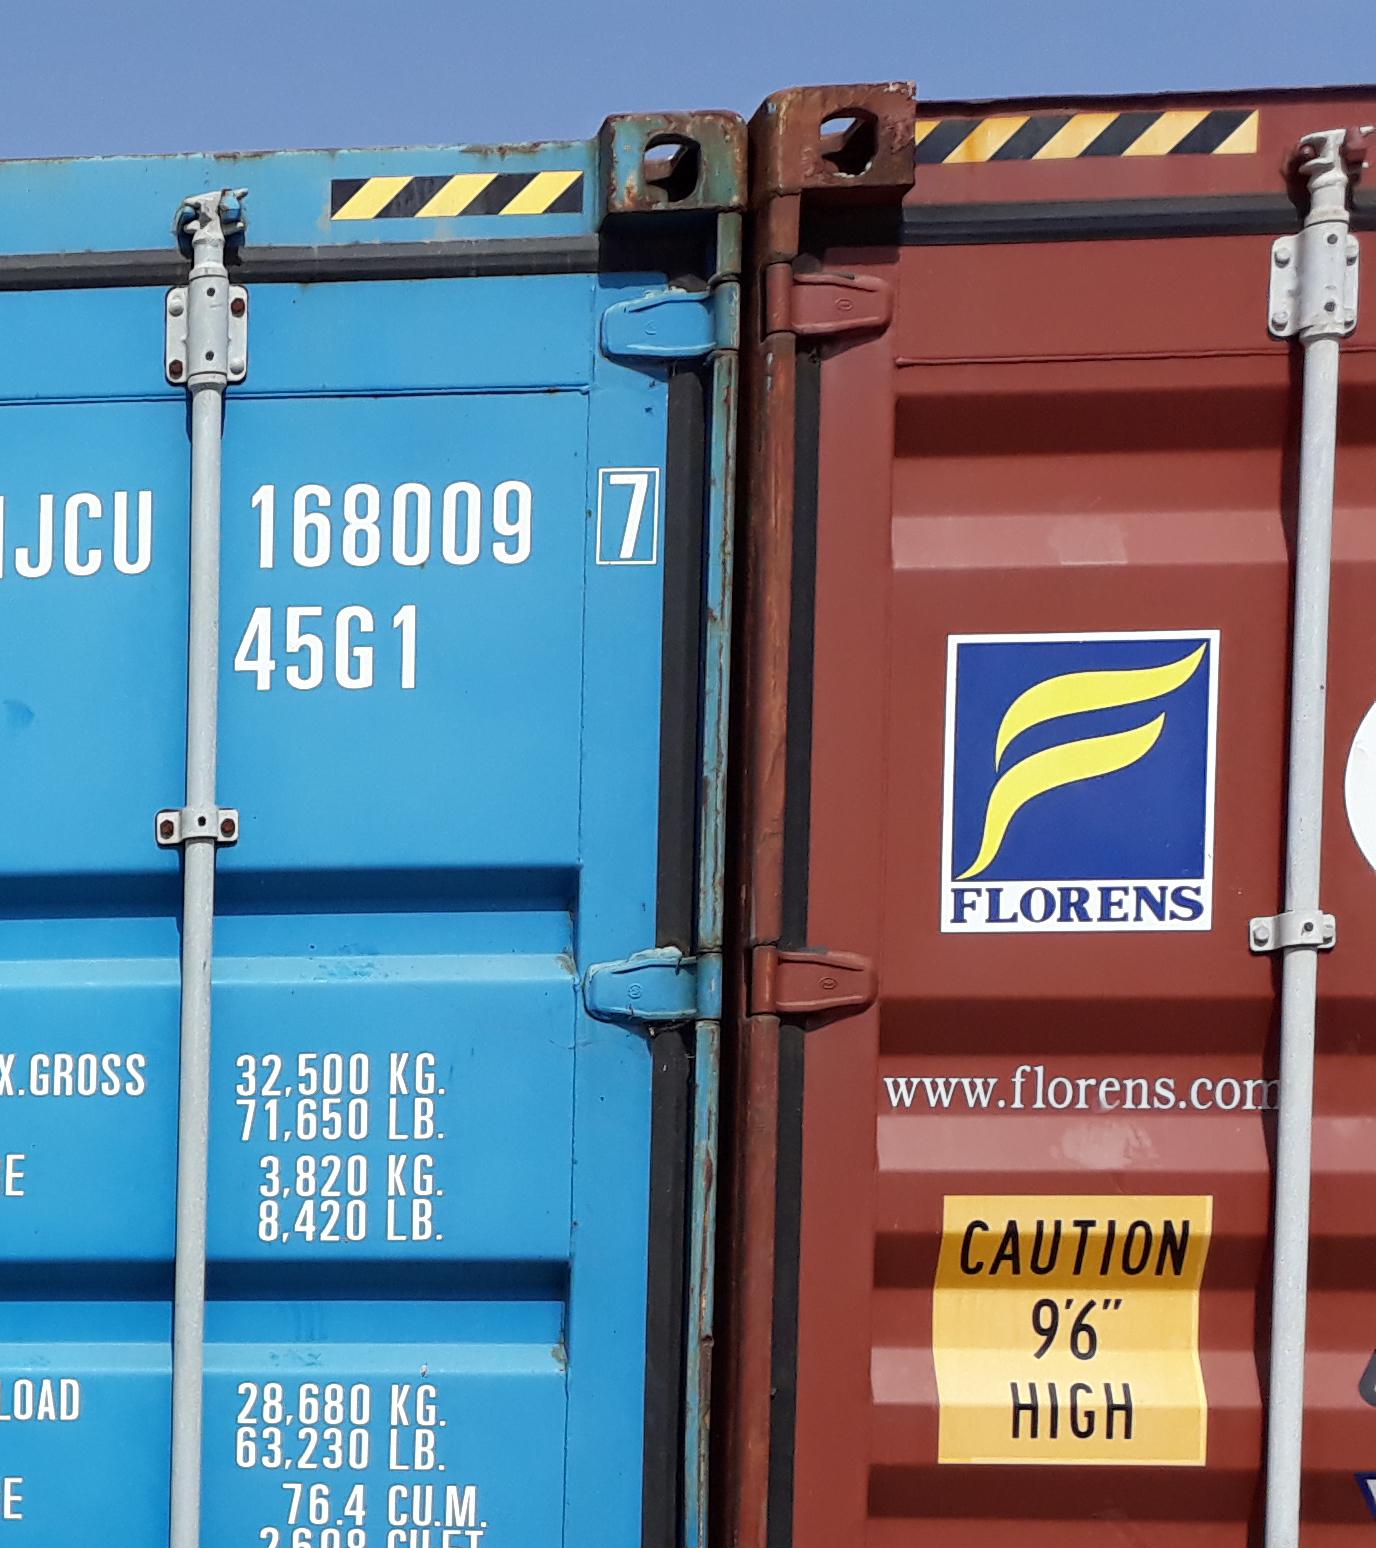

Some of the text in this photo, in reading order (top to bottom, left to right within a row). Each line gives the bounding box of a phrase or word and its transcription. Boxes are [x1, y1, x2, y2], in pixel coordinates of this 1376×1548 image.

[251, 480, 532, 569] 168009
[608, 473, 650, 559] 7
[234, 604, 419, 691] 45G1
[949, 885, 1205, 925] FLORENS
[236, 1053, 369, 1100] 32,500
[389, 1052, 446, 1095] KG.
[236, 1098, 444, 1142] 71,650 LB.
[259, 1154, 367, 1201] 3,820
[387, 1154, 443, 1197] KG.
[258, 1199, 443, 1244] 8,420 LB.
[959, 1219, 1191, 1276] CAUTION
[237, 1382, 370, 1429] 28,680
[390, 1384, 446, 1427] KG.
[1010, 1382, 1134, 1440] HIGH
[236, 1426, 445, 1471] 63,230 LB.
[282, 1483, 366, 1526] 76.4
[388, 1484, 487, 1528] CU.M.
